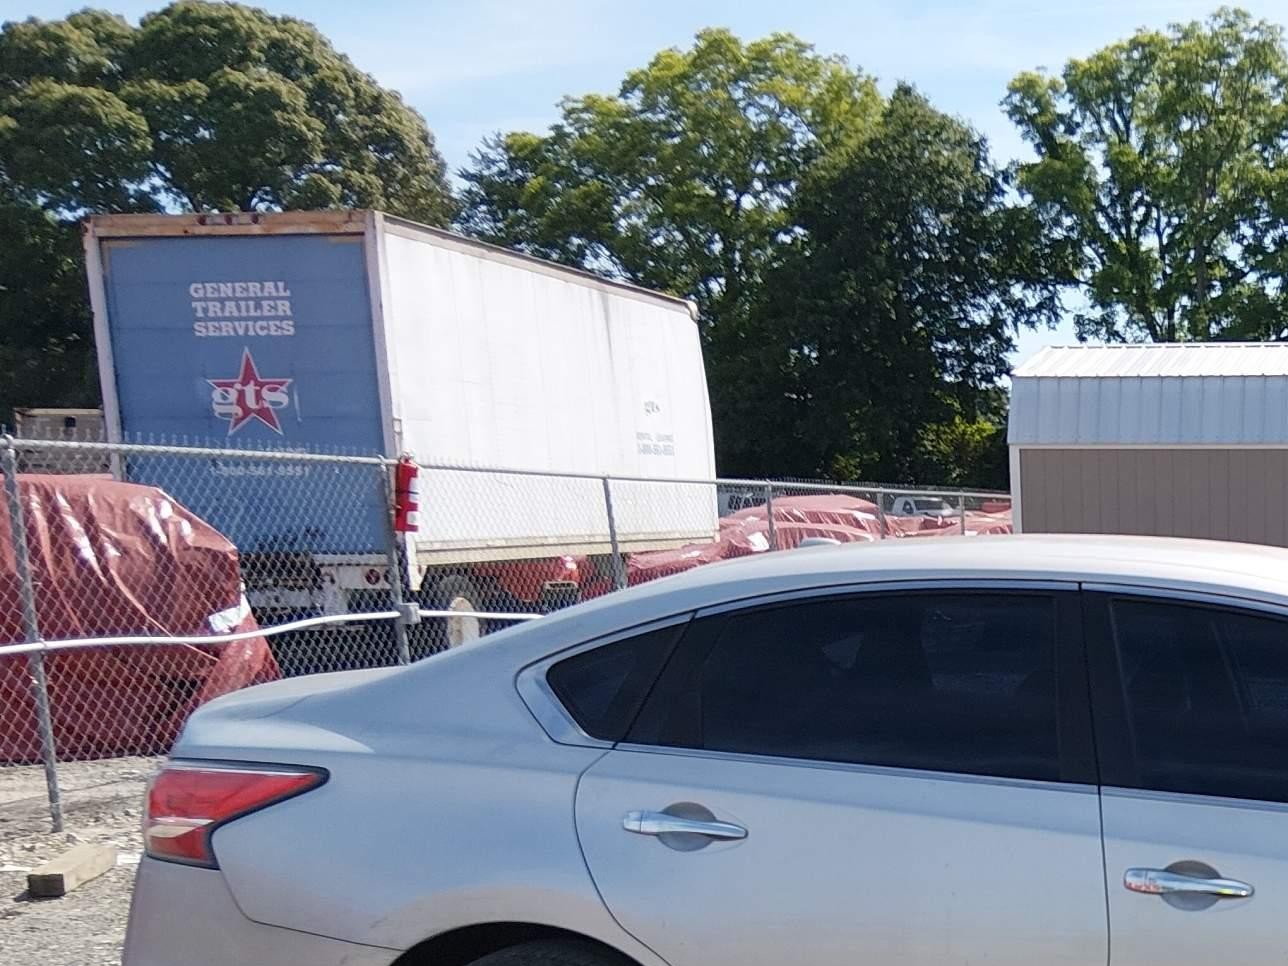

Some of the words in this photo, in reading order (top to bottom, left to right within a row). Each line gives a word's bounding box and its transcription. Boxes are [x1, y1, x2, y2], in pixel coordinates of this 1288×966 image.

[190, 282, 290, 297] GENERAL
[192, 301, 292, 316] TRAILER
[194, 321, 295, 336] SERVICES
[212, 381, 289, 419] gts
